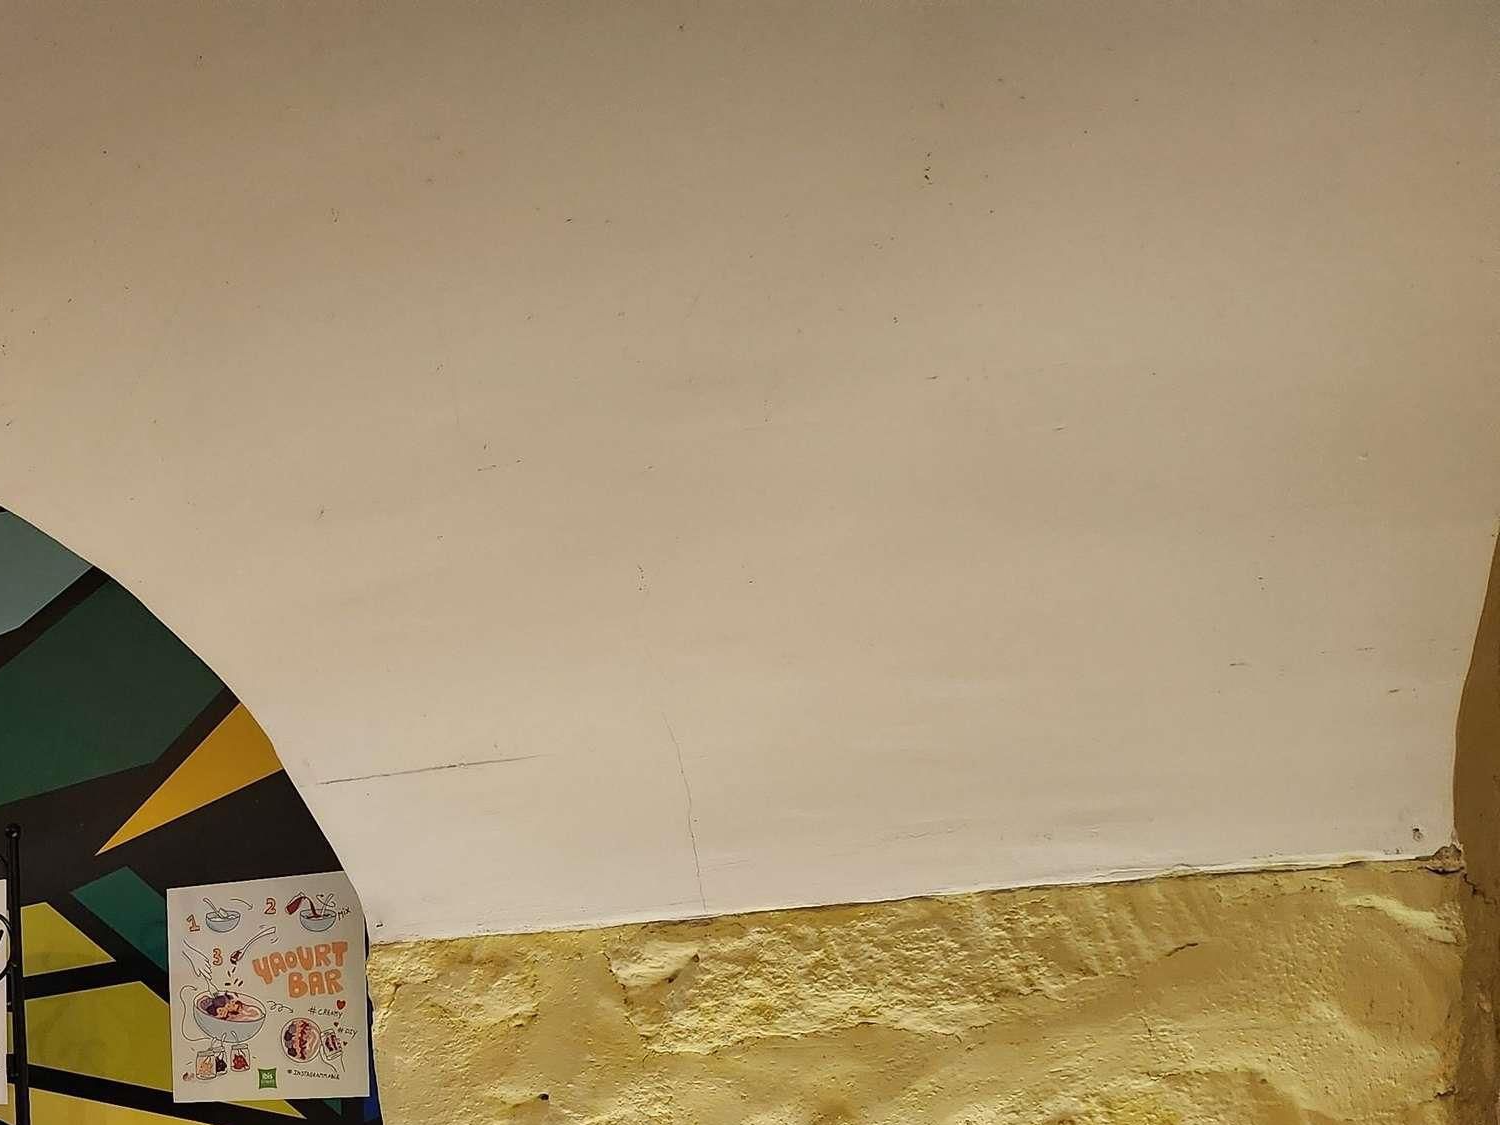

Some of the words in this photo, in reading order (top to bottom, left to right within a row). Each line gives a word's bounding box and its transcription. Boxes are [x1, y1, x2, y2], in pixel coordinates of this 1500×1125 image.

[264, 897, 277, 915] 2
[187, 914, 200, 932] 1
[212, 947, 223, 966] 3
[252, 941, 349, 984] YAOURT
[288, 969, 345, 998] BAR
